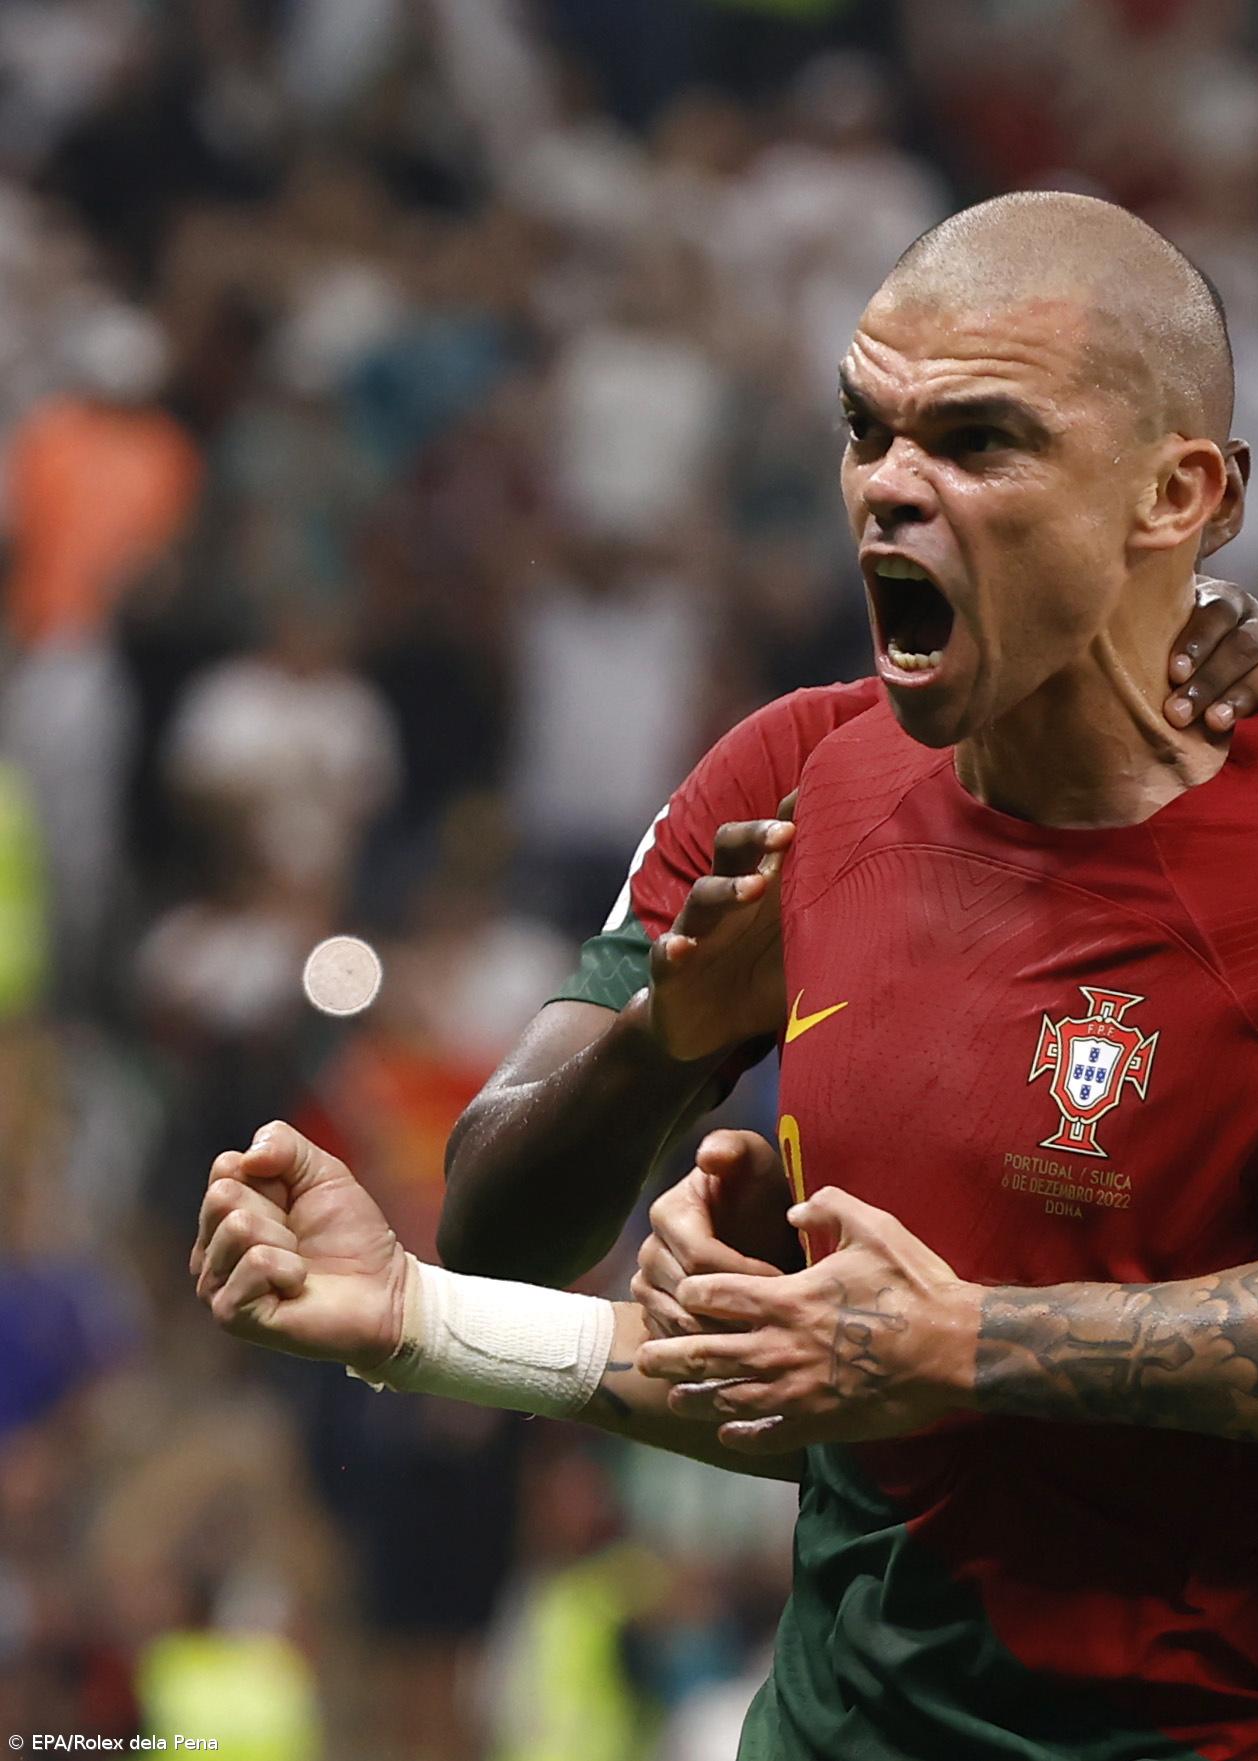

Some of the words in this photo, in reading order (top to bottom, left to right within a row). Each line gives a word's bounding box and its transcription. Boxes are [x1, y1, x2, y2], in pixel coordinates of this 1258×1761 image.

[1003, 1152, 1073, 1180] PORTUGAL
[1001, 1174, 1009, 1188] 6
[1012, 1174, 1026, 1191] DE
[1029, 1177, 1093, 1203] DEZEMBRO
[1096, 1190, 1131, 1209] 2022
[1045, 1199, 1082, 1218] DOHA
